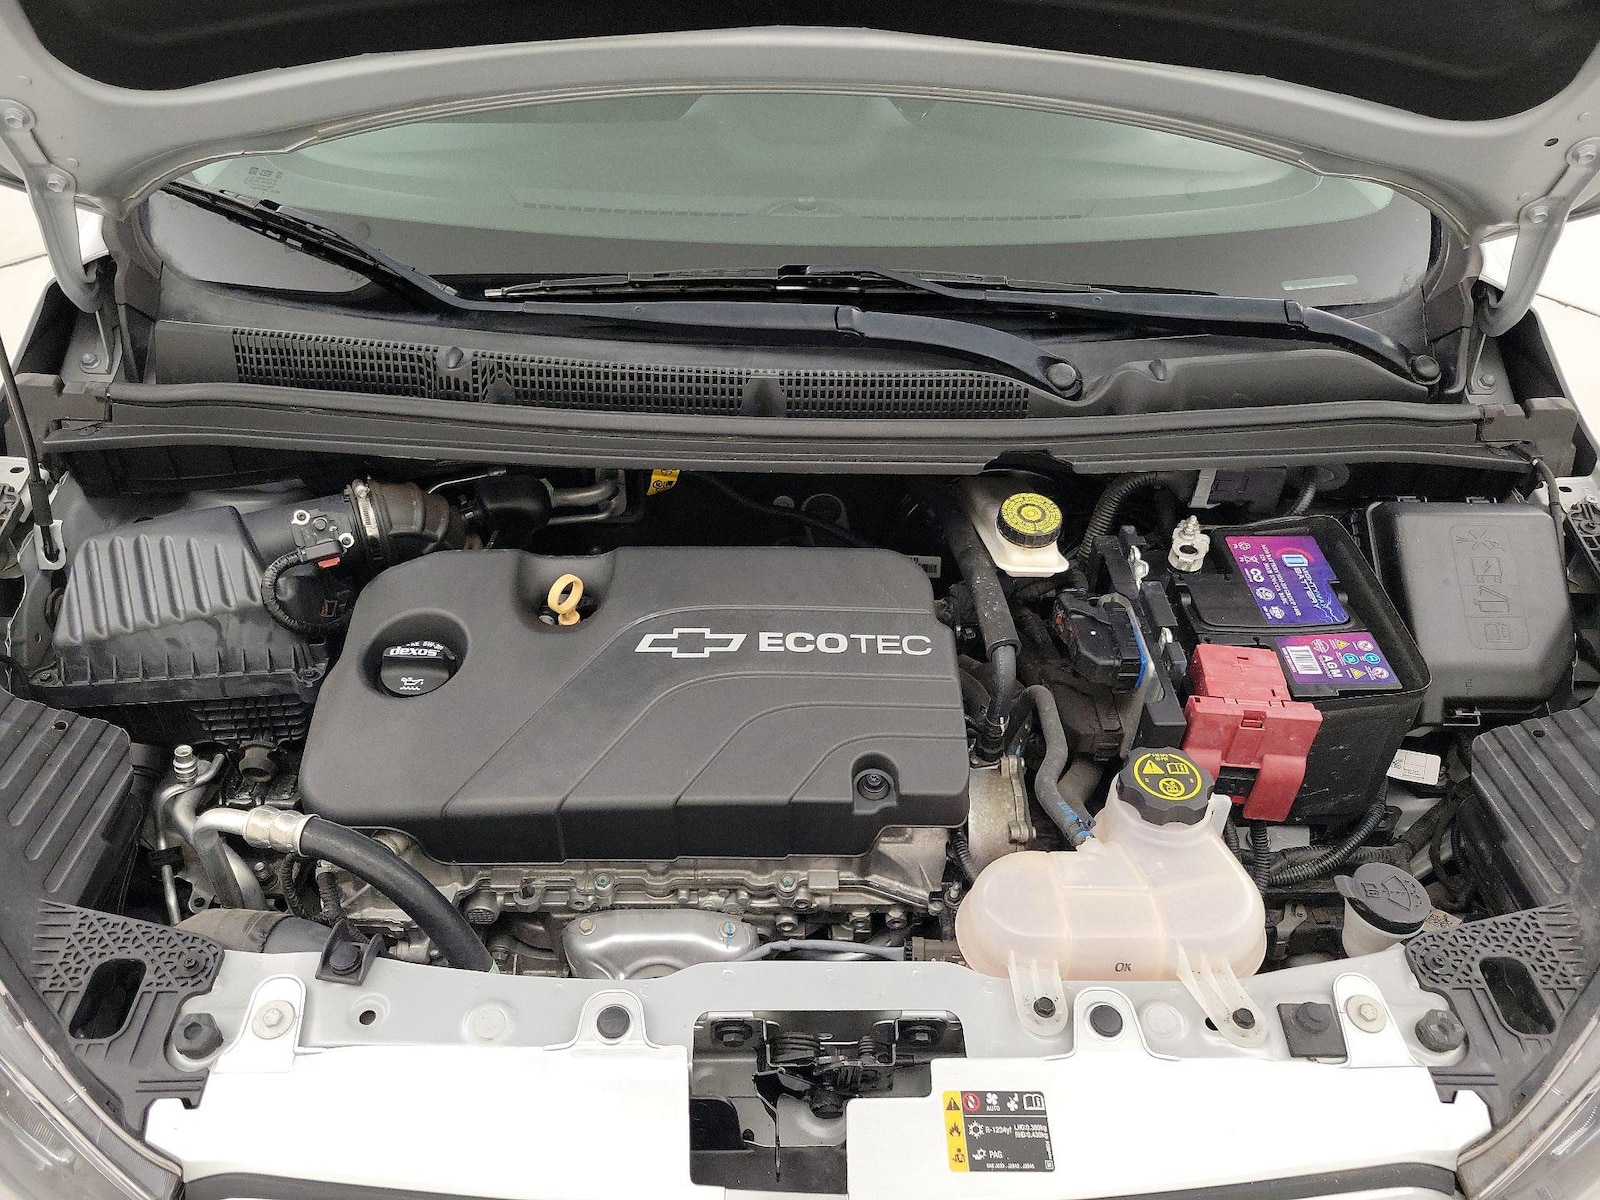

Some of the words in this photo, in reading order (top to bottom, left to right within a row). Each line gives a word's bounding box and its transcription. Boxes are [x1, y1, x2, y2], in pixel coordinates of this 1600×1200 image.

[1293, 567, 1321, 609] BATTERY
[758, 631, 932, 655] ECOTEC
[389, 646, 441, 657] dexos
[1321, 655, 1344, 677] AGM
[1115, 962, 1132, 972] OK
[989, 1150, 1003, 1159] PAG
